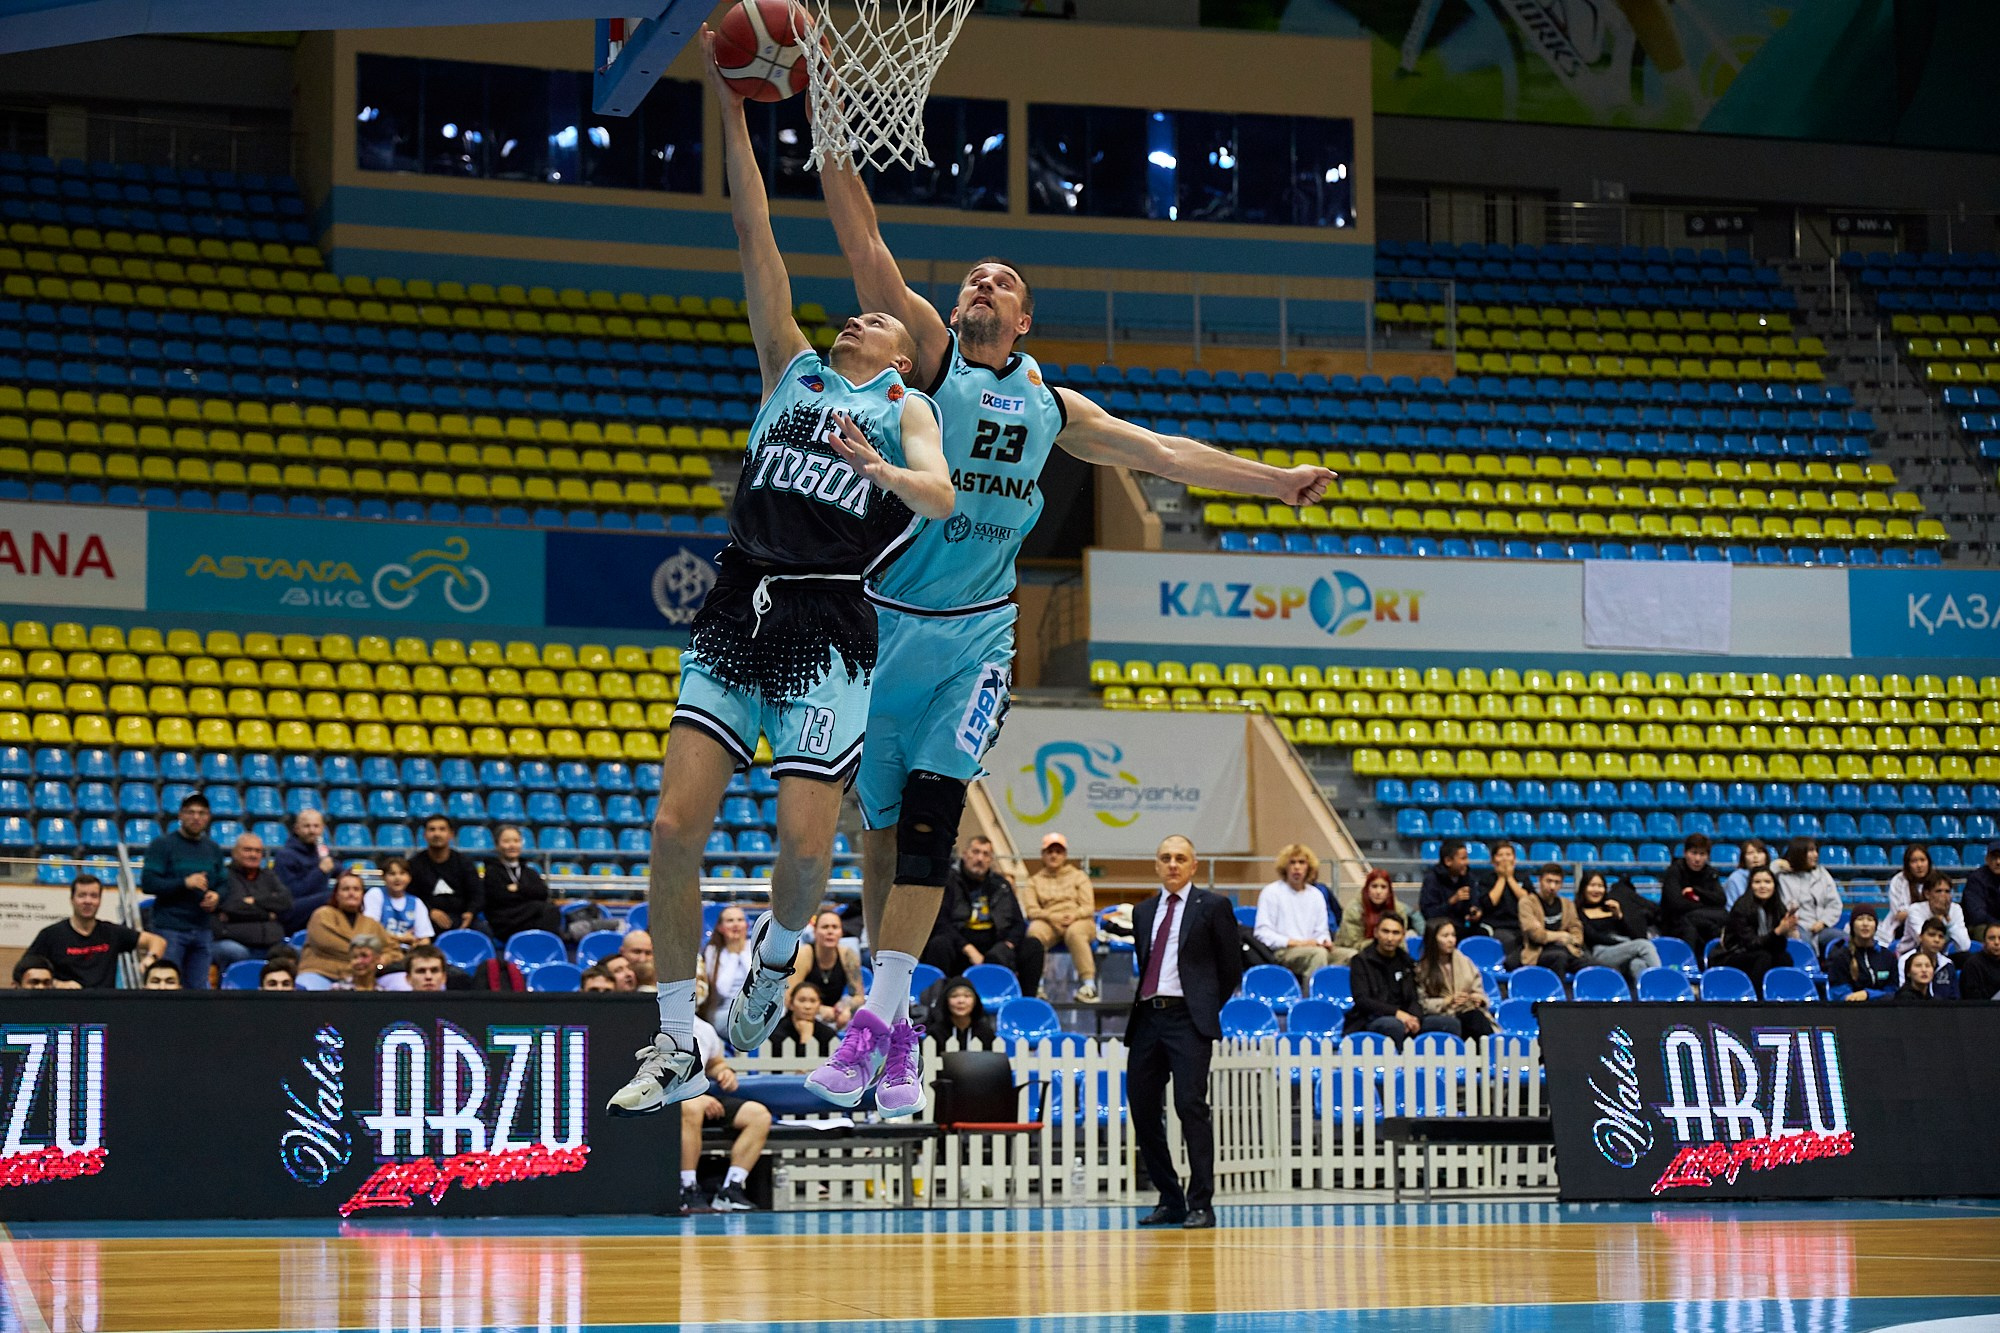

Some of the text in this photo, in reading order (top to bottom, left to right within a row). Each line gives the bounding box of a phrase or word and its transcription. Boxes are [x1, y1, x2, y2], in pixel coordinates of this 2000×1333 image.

[970, 419, 1027, 464] 23
[751, 443, 872, 518] ТОБОЛ
[951, 468, 1035, 507] ASTANA
[186, 554, 362, 584] ASTANA
[798, 705, 836, 756] 13
[1087, 781, 1200, 808] Saryarka
[357, 1022, 588, 1157] ARZU
[1587, 1024, 1654, 1169] Water
[1657, 1024, 1849, 1142] ARZU
